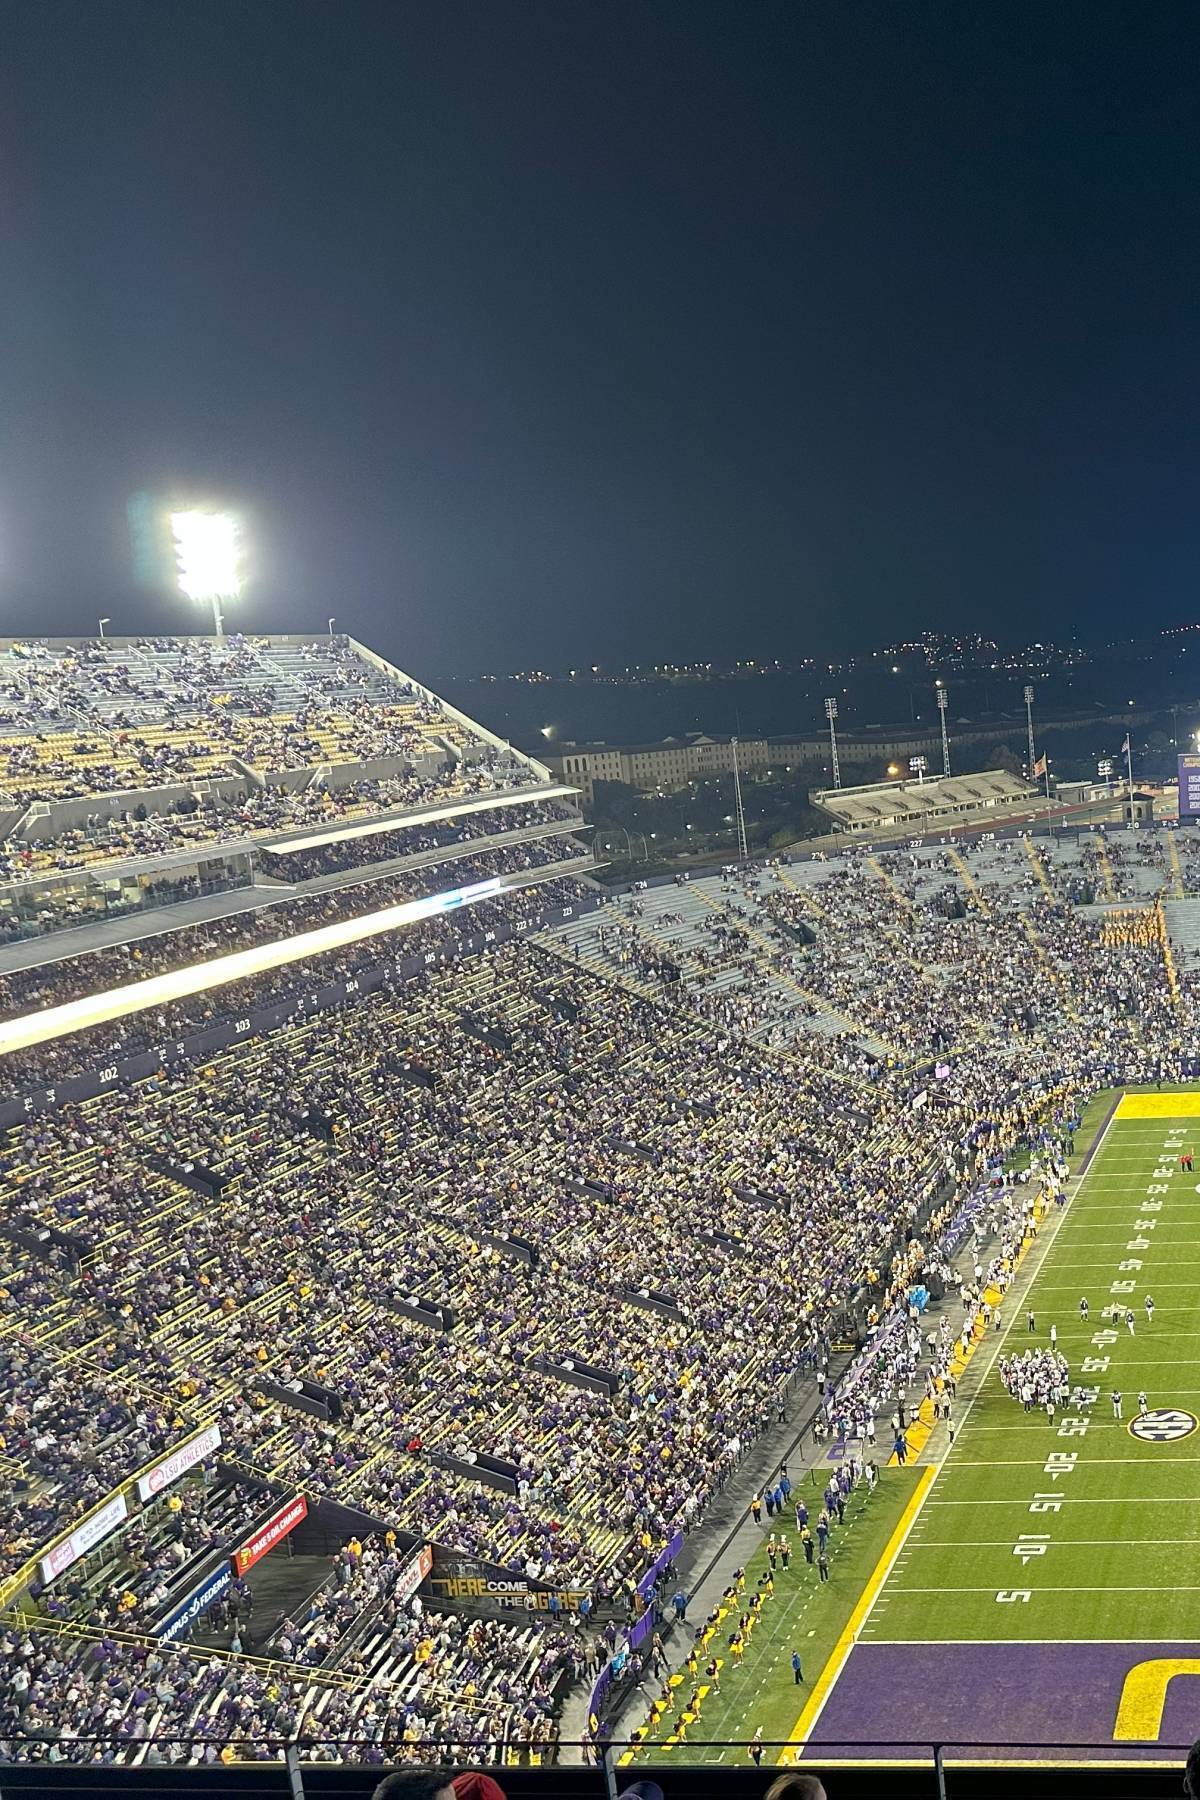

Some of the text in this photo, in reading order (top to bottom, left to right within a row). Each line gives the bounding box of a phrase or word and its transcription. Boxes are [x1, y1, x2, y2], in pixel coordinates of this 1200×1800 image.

[910, 839, 923, 847] 227
[485, 933, 496, 942] 106
[424, 954, 436, 964] 105
[346, 980, 359, 993] 104
[235, 1019, 250, 1034] 103
[99, 1066, 118, 1083] 102
[1133, 1219, 1157, 1229] 35
[1118, 1258, 1143, 1270] 45
[1110, 1280, 1136, 1293] 50
[1091, 1329, 1119, 1344] 40
[1081, 1356, 1111, 1372] 35
[1057, 1418, 1090, 1436] 25
[180, 1439, 214, 1468] ATHLETICS
[1043, 1452, 1078, 1472] 20
[1028, 1492, 1065, 1512] 15
[251, 1536, 268, 1556] TAKE
[280, 1502, 304, 1530] CHANGE
[1012, 1534, 1051, 1555] 10
[436, 1578, 488, 1597] HERE
[487, 1581, 528, 1592] COME
[495, 1596, 523, 1607] THE
[995, 1591, 1032, 1603] 5
[158, 1572, 231, 1648] CAMPUS FEDERAL
